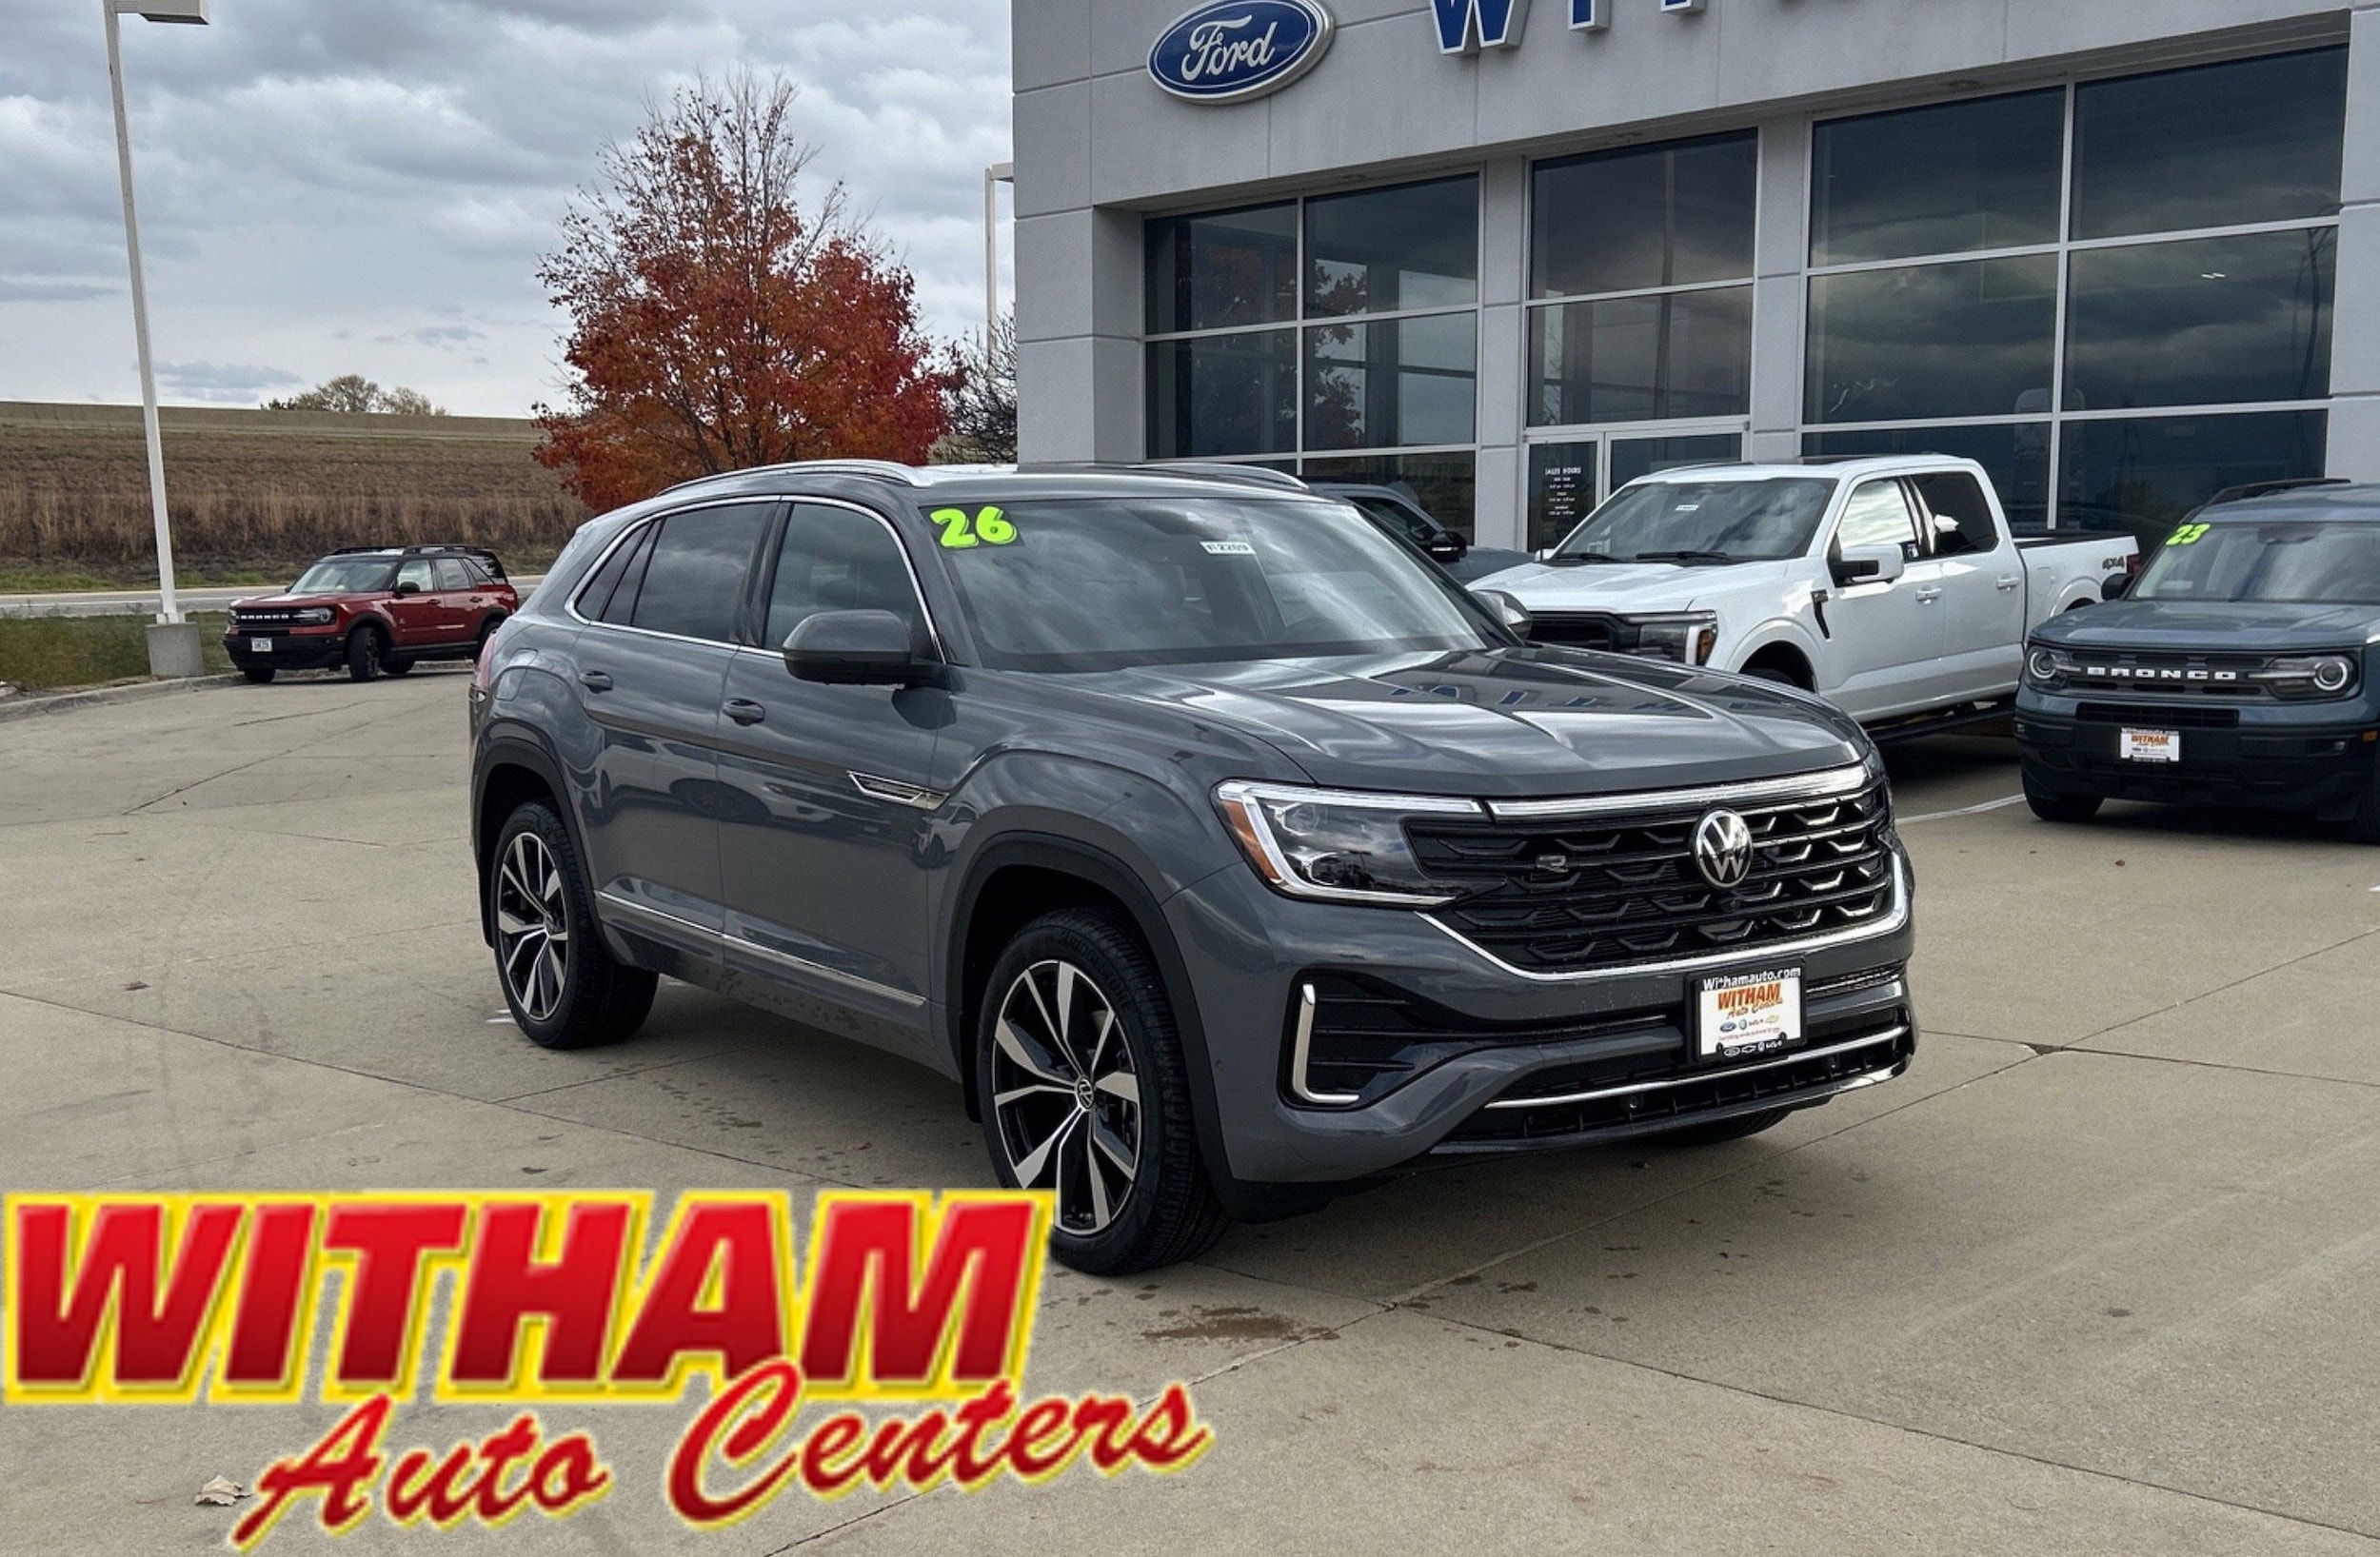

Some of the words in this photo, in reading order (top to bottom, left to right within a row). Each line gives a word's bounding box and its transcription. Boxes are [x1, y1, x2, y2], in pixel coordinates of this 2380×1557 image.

[1180, 14, 1279, 82] Ford
[929, 506, 1018, 548] 26
[2166, 523, 2211, 546] 23
[2087, 666, 2237, 680] BRONCO
[1717, 982, 1781, 1010] WITHAM
